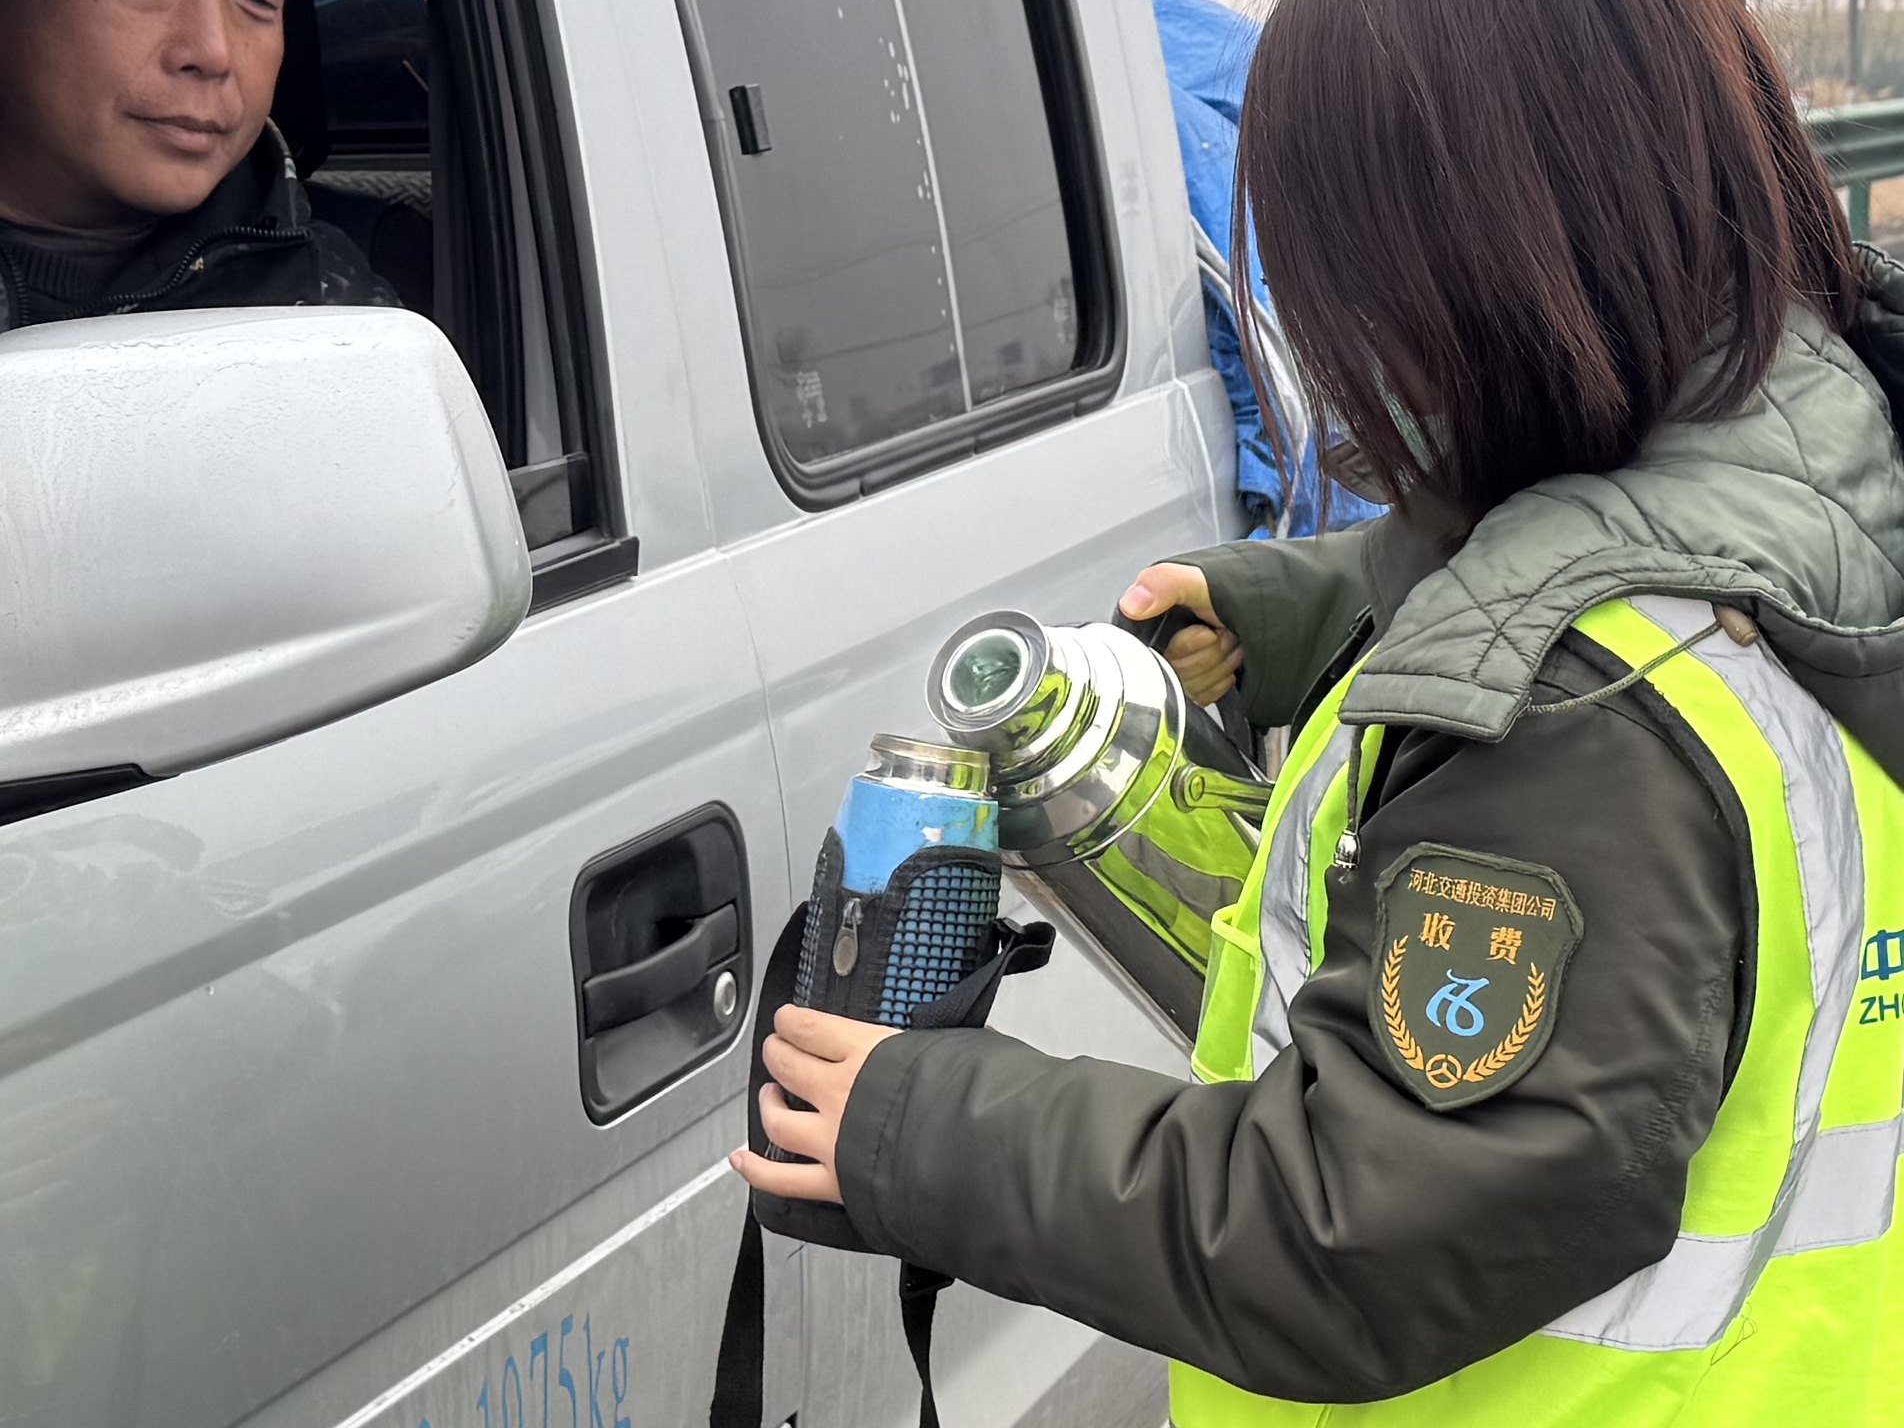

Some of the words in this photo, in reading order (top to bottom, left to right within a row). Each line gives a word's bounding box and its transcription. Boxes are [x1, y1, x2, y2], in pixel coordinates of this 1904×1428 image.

[1408, 868, 1557, 922] 河北交通投资集团公司
